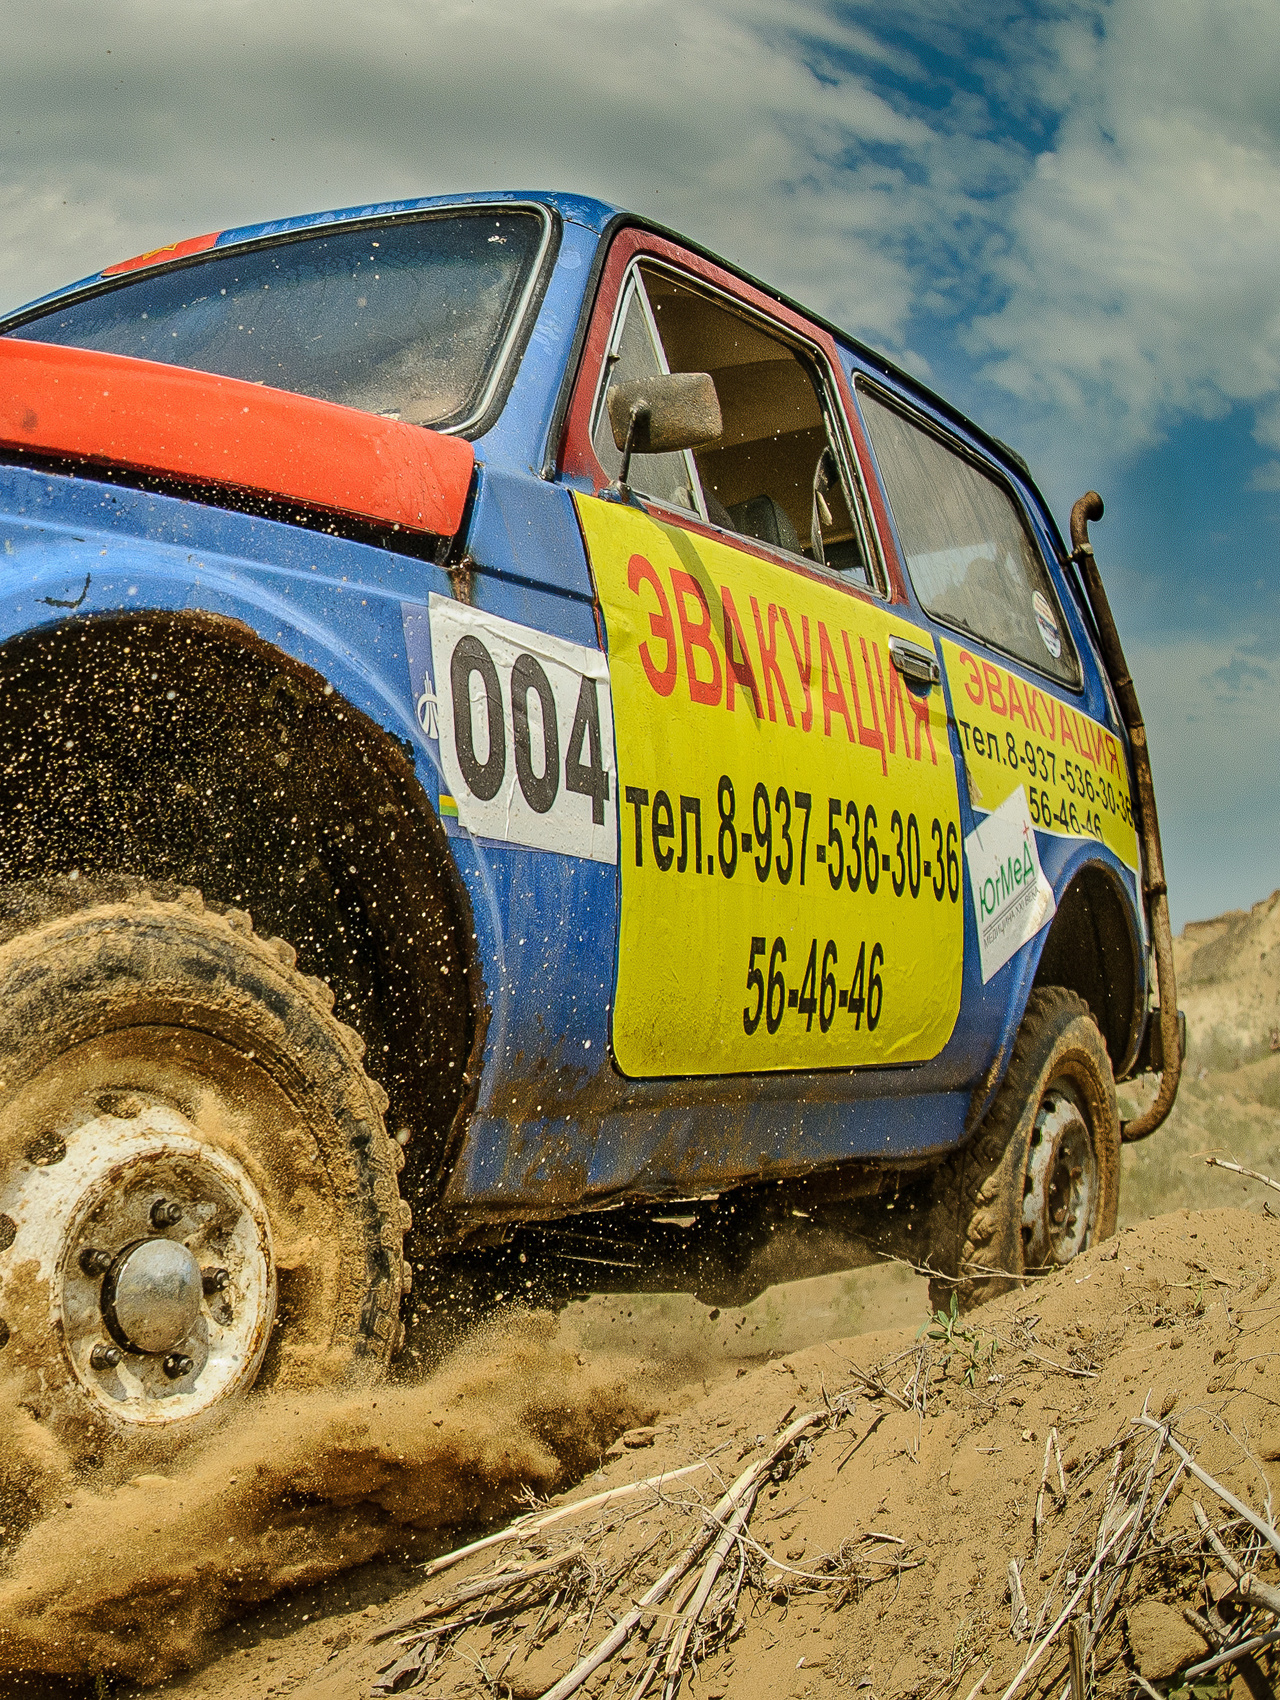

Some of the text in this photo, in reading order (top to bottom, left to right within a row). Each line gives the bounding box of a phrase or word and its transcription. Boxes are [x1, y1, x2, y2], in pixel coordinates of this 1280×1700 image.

[451, 635, 610, 826] 004
[959, 650, 1122, 780] ЭВАКУАЦИЯ
[625, 775, 960, 904] тел.8-937-536-30-36
[1028, 785, 1104, 842] 56-46-46
[743, 936, 884, 1036] 56-46-46
